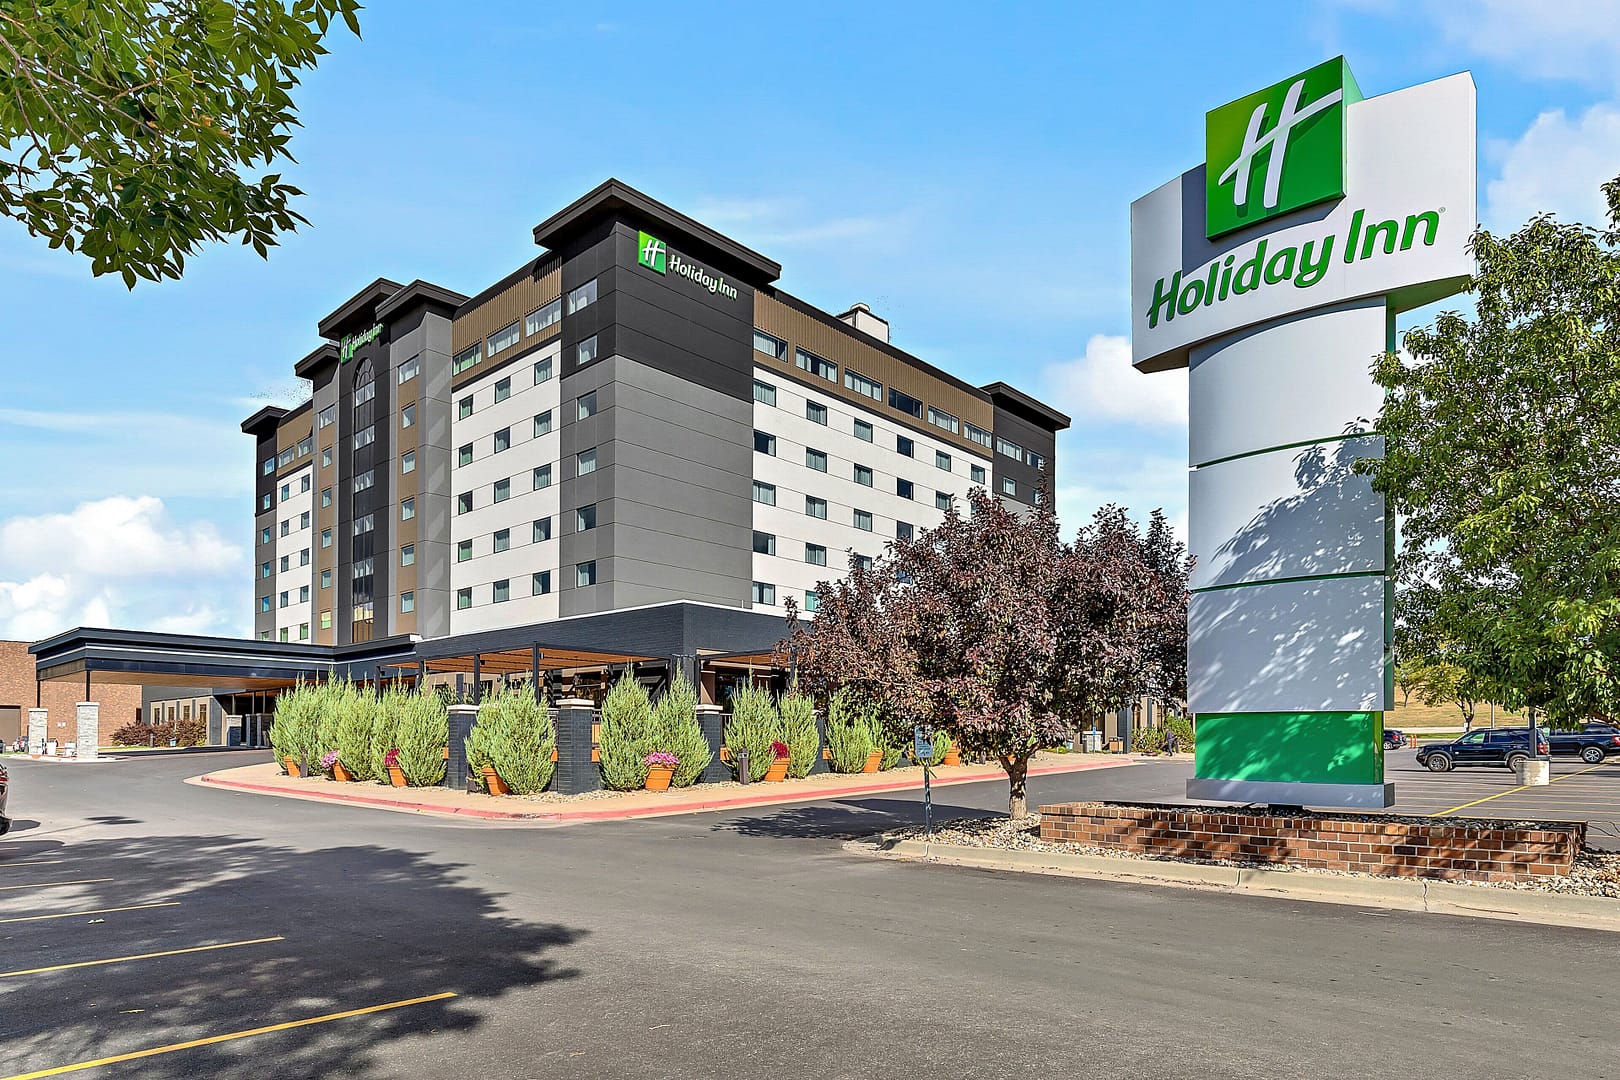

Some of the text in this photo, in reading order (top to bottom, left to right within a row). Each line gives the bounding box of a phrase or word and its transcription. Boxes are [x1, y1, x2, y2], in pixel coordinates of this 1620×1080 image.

[669, 254, 738, 299] Holiday Inn
[1147, 208, 1440, 329] Holiday Inn
